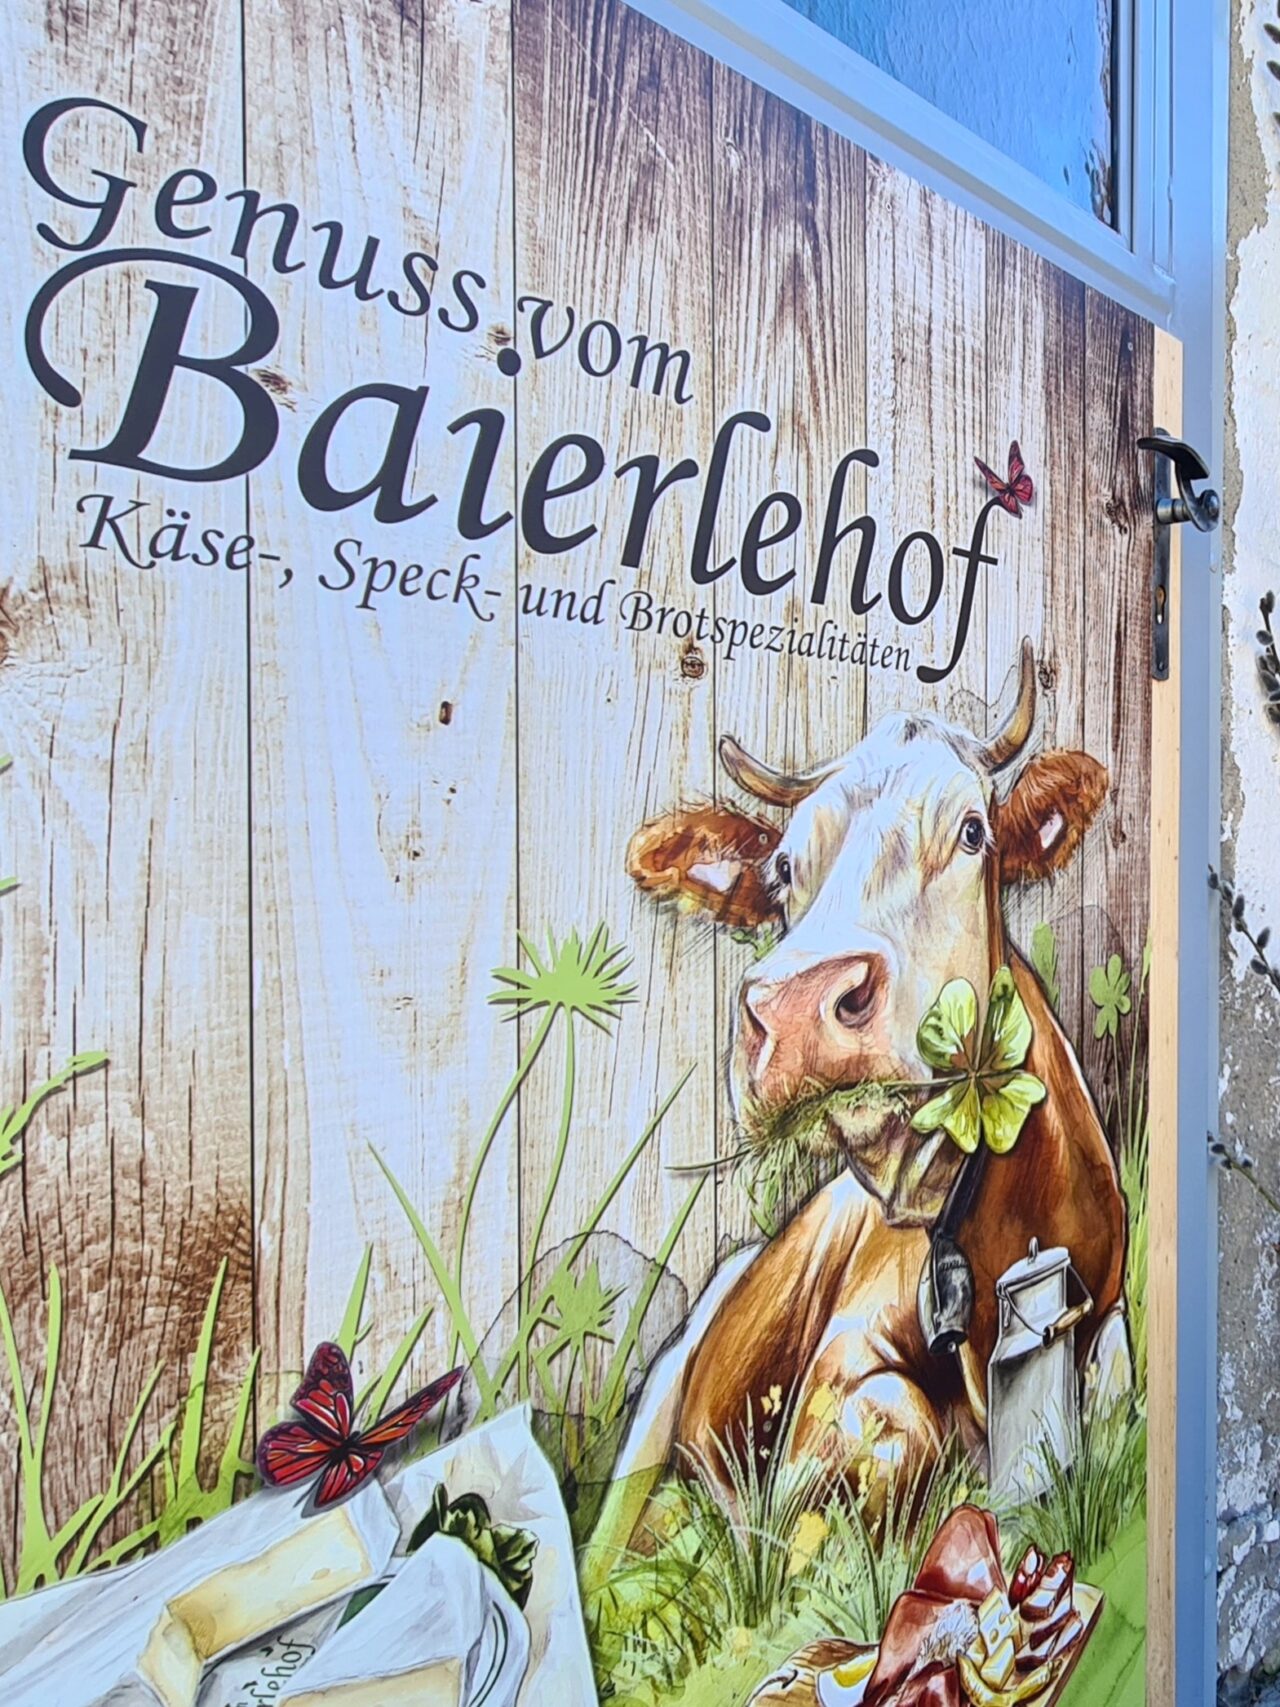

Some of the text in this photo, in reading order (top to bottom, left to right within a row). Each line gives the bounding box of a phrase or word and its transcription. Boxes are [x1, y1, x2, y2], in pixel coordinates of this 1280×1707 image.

[22, 97, 693, 405] Genuss vom
[24, 247, 1002, 684] Baierlehof
[76, 494, 911, 673] Käse-, Speck- und Brotspezialitäten
